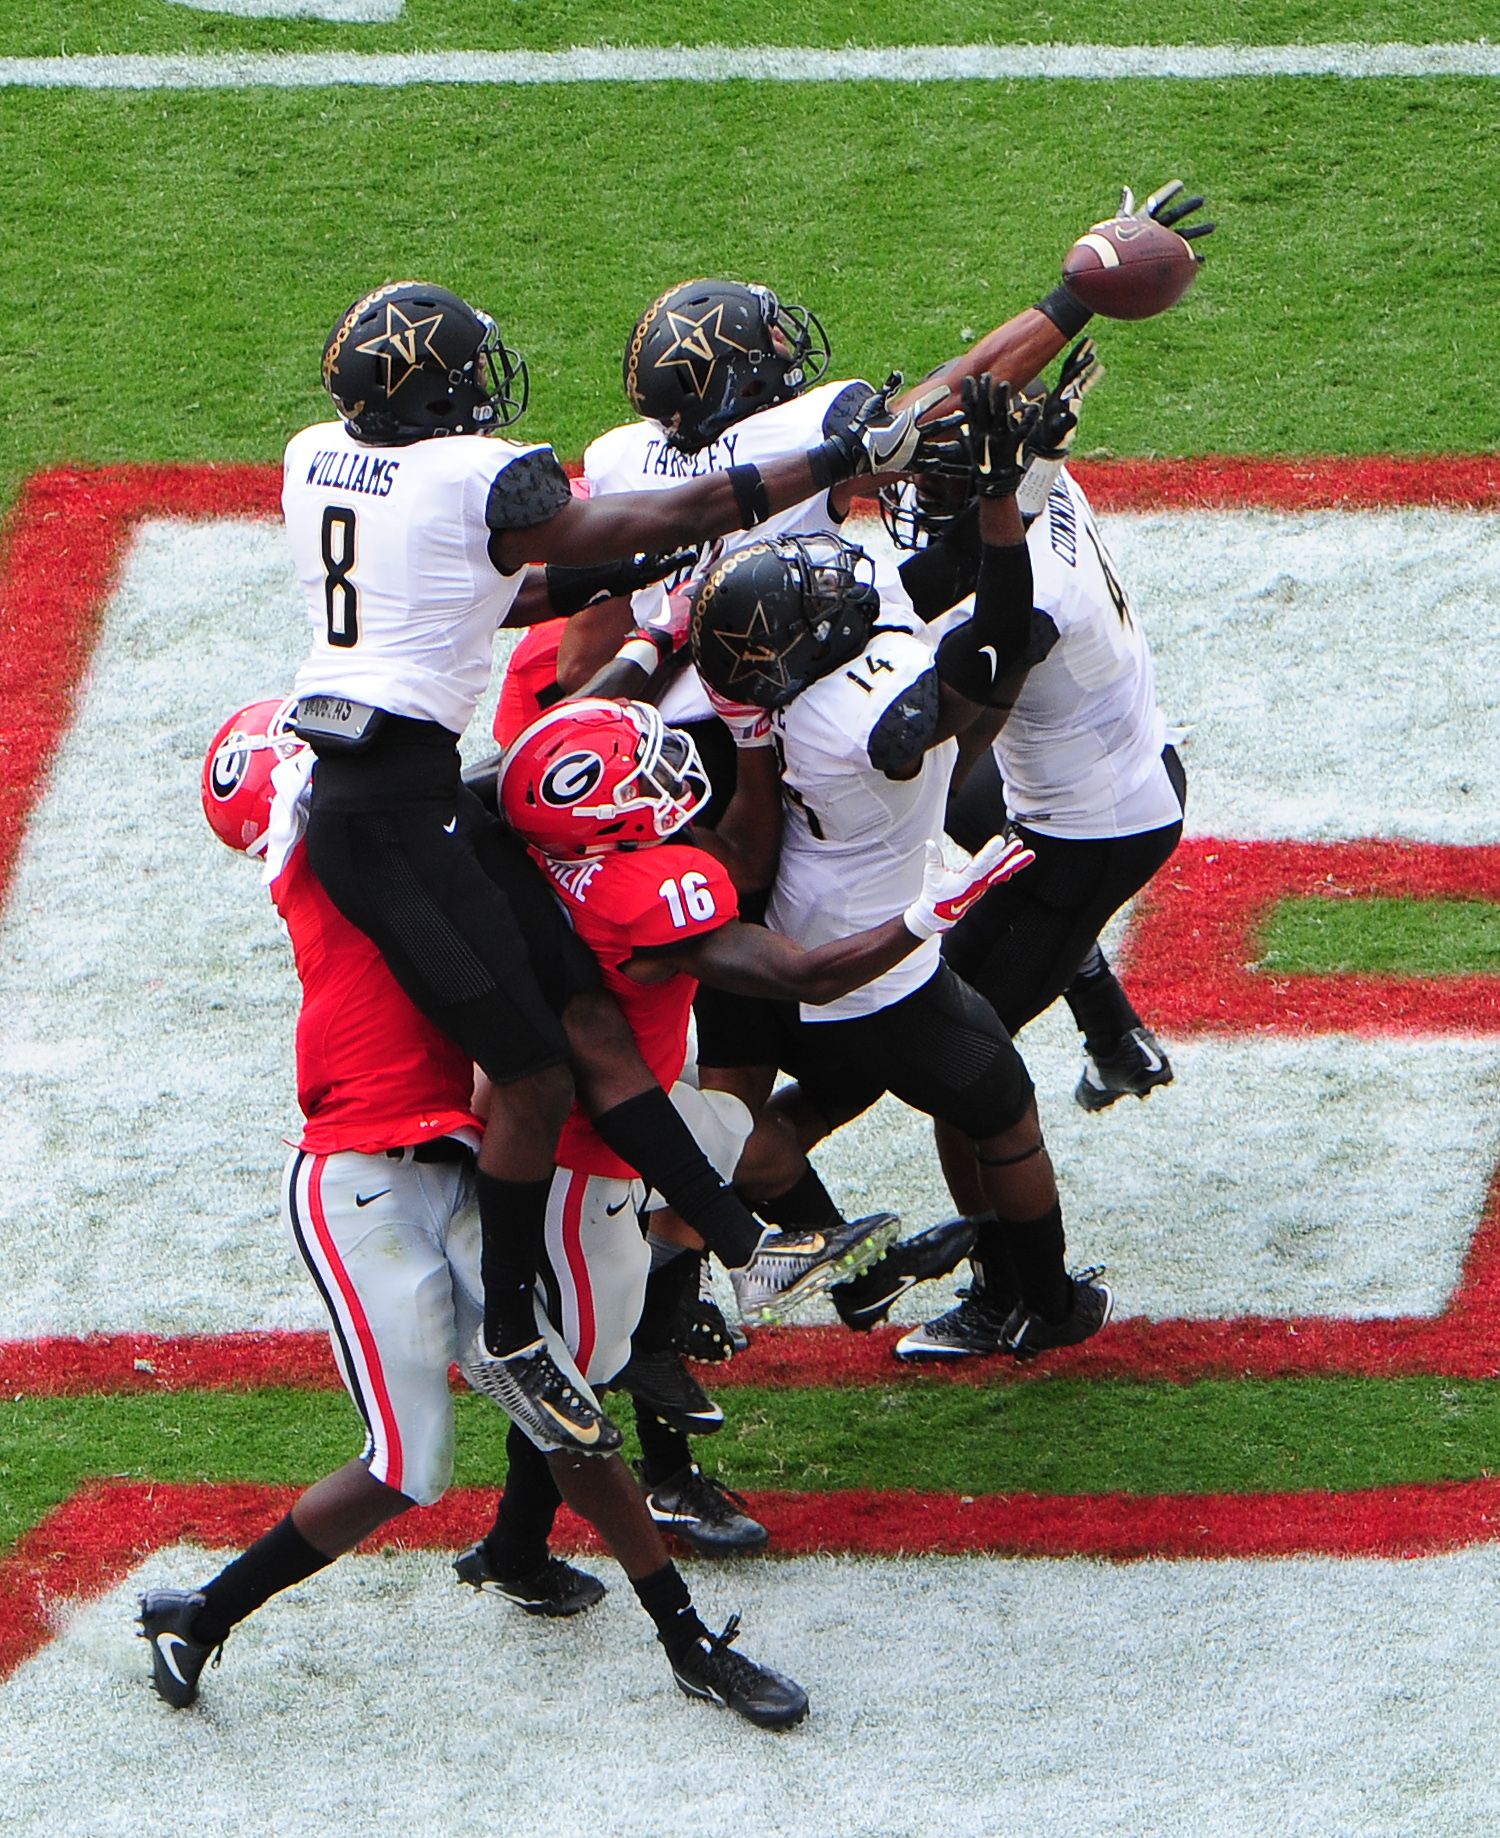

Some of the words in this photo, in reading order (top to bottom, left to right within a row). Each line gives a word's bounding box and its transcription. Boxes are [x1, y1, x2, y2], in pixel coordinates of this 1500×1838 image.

[305, 450, 400, 497] WILLIAMS
[321, 505, 359, 649] 8
[846, 655, 895, 694] 14
[546, 752, 602, 803] G
[658, 871, 716, 928] 16
